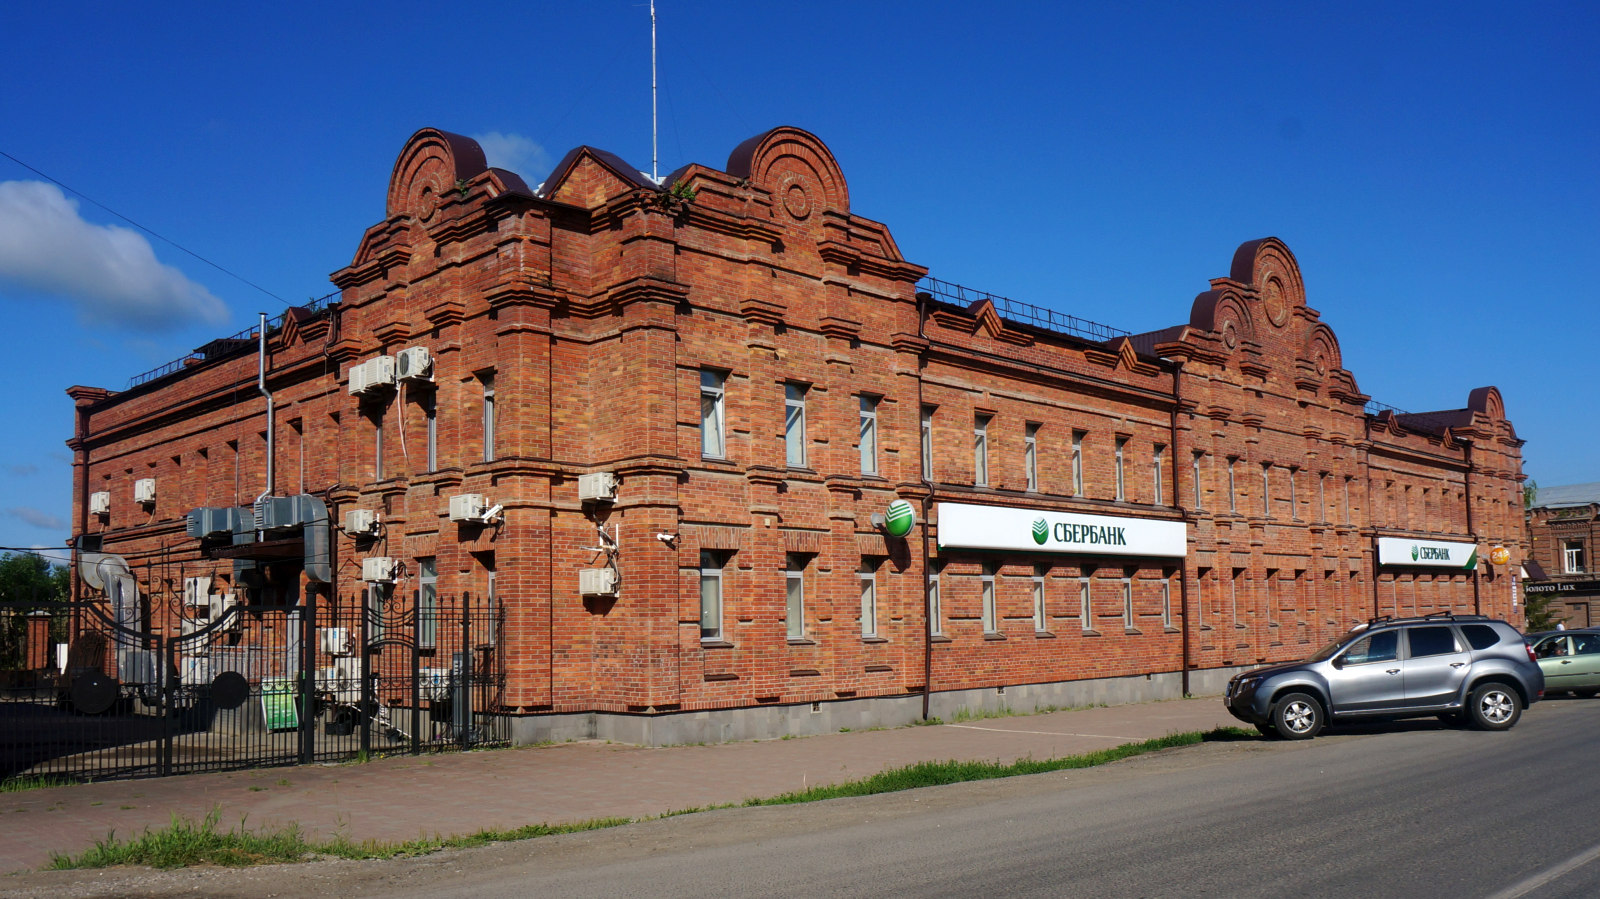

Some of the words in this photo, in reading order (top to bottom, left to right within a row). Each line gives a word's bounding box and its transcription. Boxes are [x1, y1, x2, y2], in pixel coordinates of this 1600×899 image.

[1054, 522, 1126, 546] СБЕРБАНК
[1420, 546, 1450, 560] СБЕРБАНК
[1492, 551, 1503, 559] 24
[1557, 583, 1576, 591] Lux
